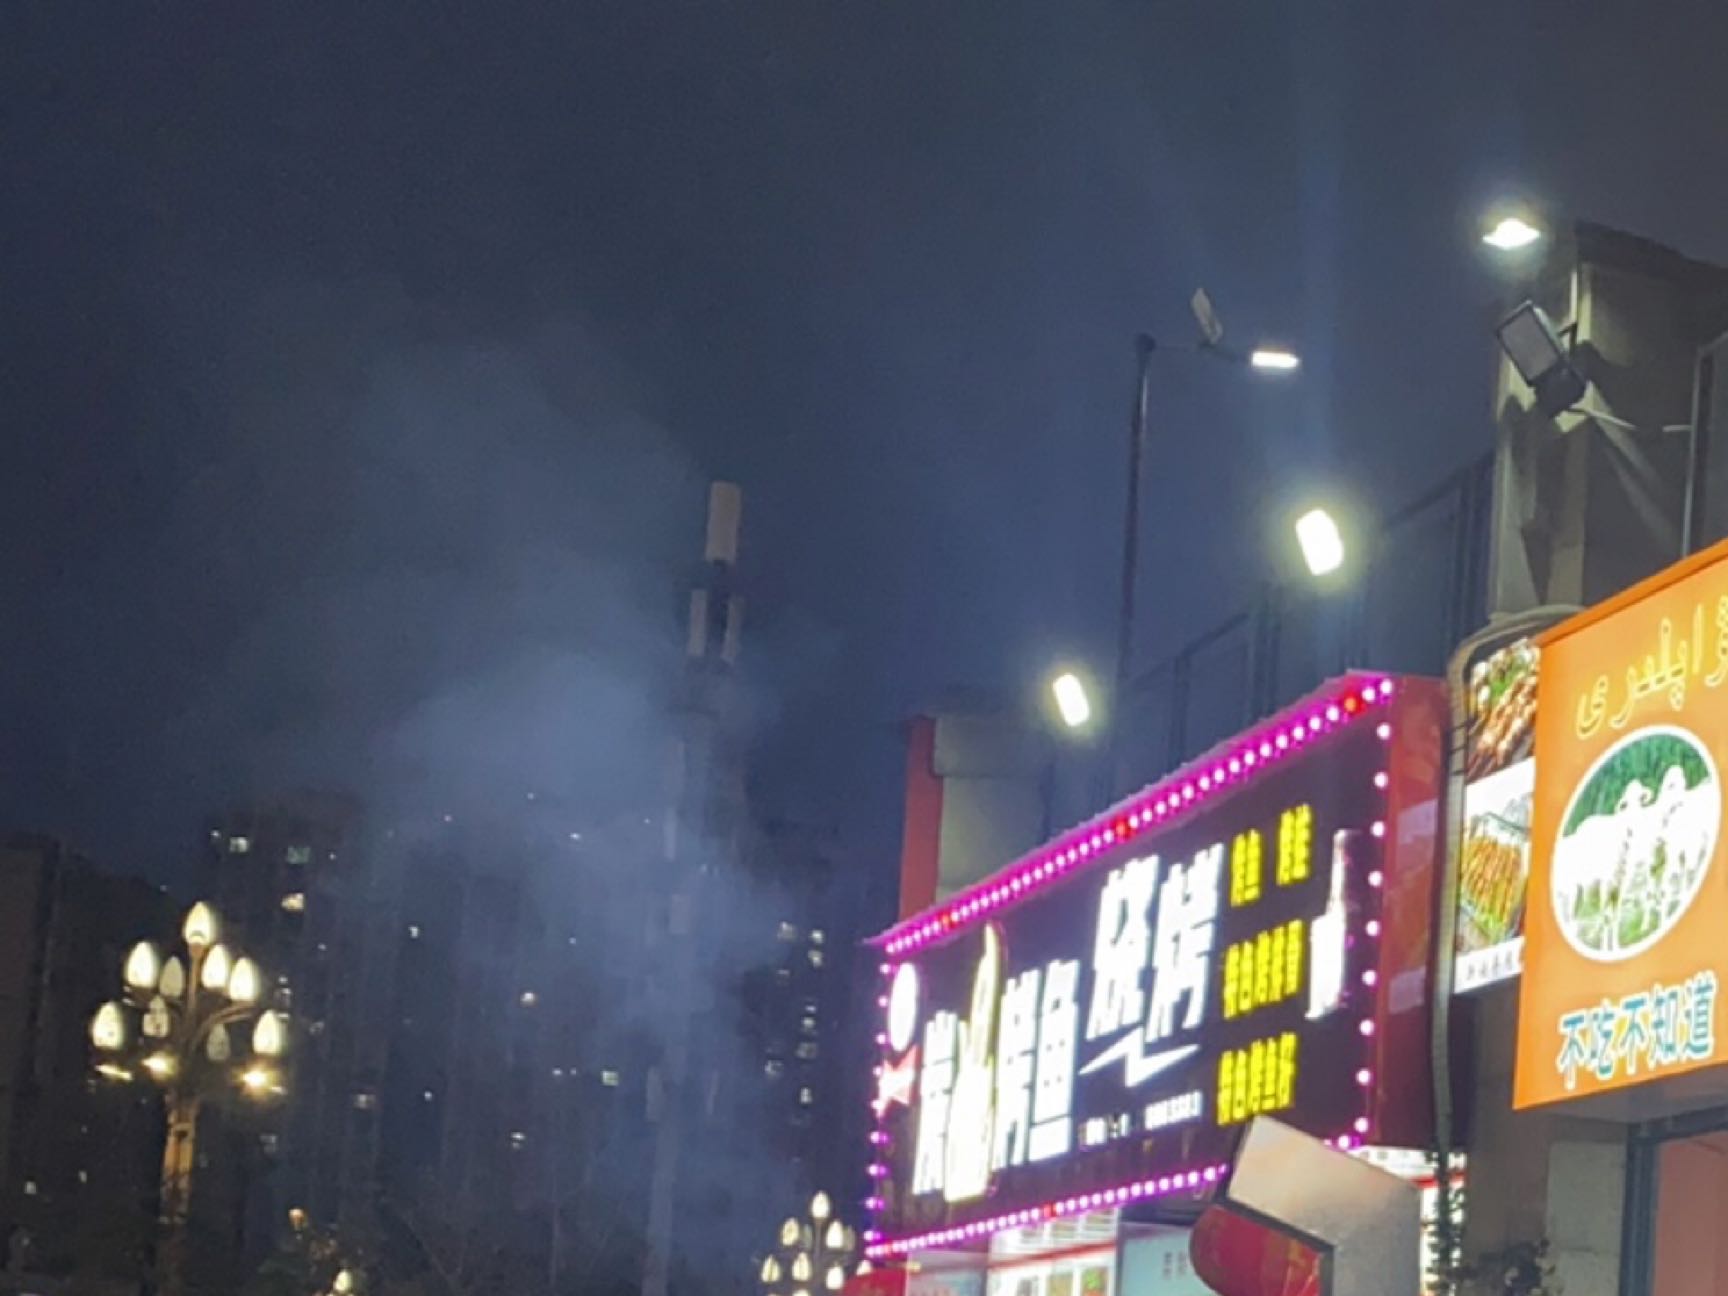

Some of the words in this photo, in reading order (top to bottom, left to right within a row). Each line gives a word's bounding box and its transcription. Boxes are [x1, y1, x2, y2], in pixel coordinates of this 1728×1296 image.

[1558, 980, 1716, 1083] 不吃不知道
